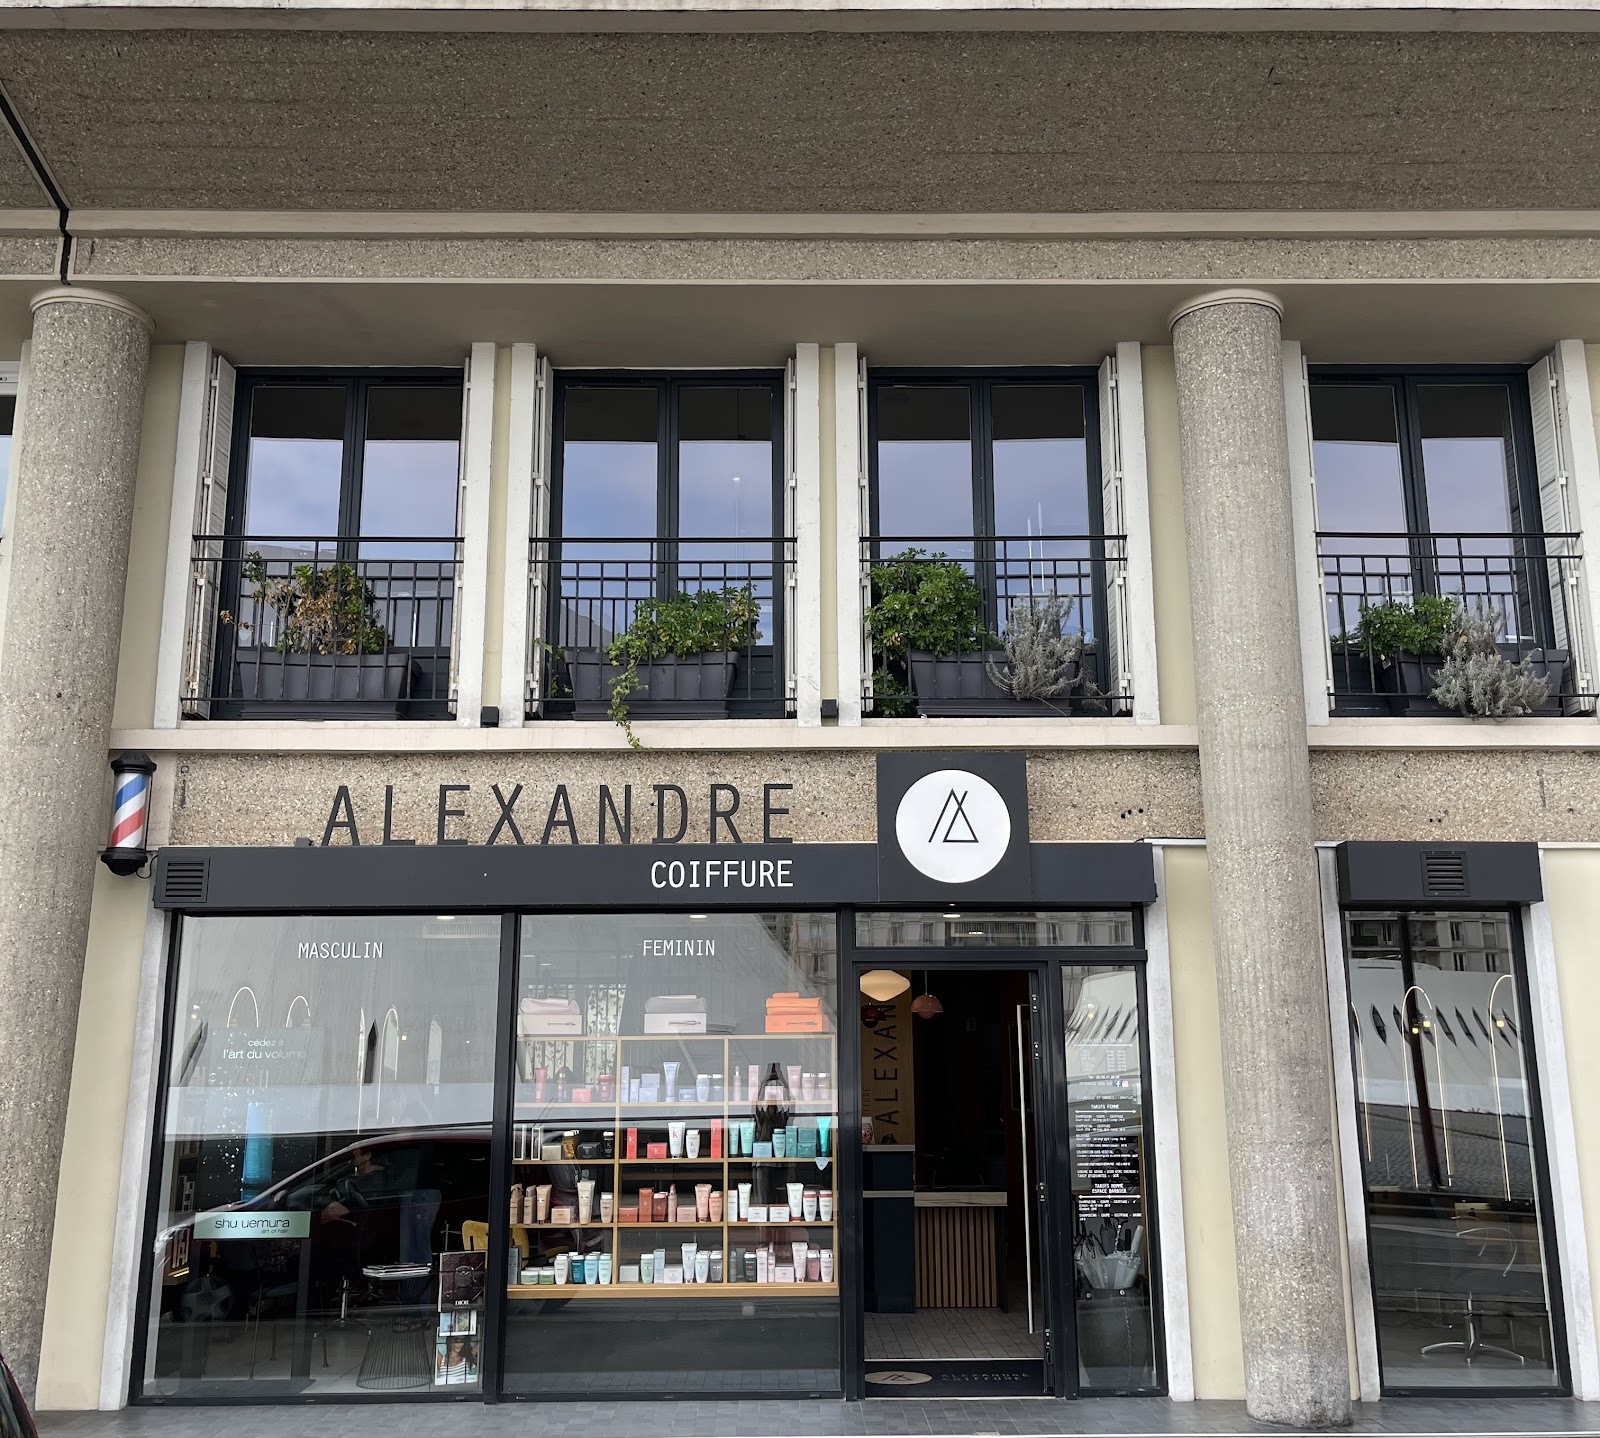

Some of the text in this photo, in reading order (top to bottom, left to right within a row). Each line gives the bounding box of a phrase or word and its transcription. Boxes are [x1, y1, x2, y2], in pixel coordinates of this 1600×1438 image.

[321, 784, 794, 847] ALEXANDRE
[649, 860, 794, 889] COIFFURE
[298, 942, 384, 960] MASCULIN
[642, 939, 716, 957] FEMININ
[247, 1039, 276, 1047] cédez
[222, 1049, 307, 1059] l'art du volume
[214, 1219, 290, 1229] shu uemura
